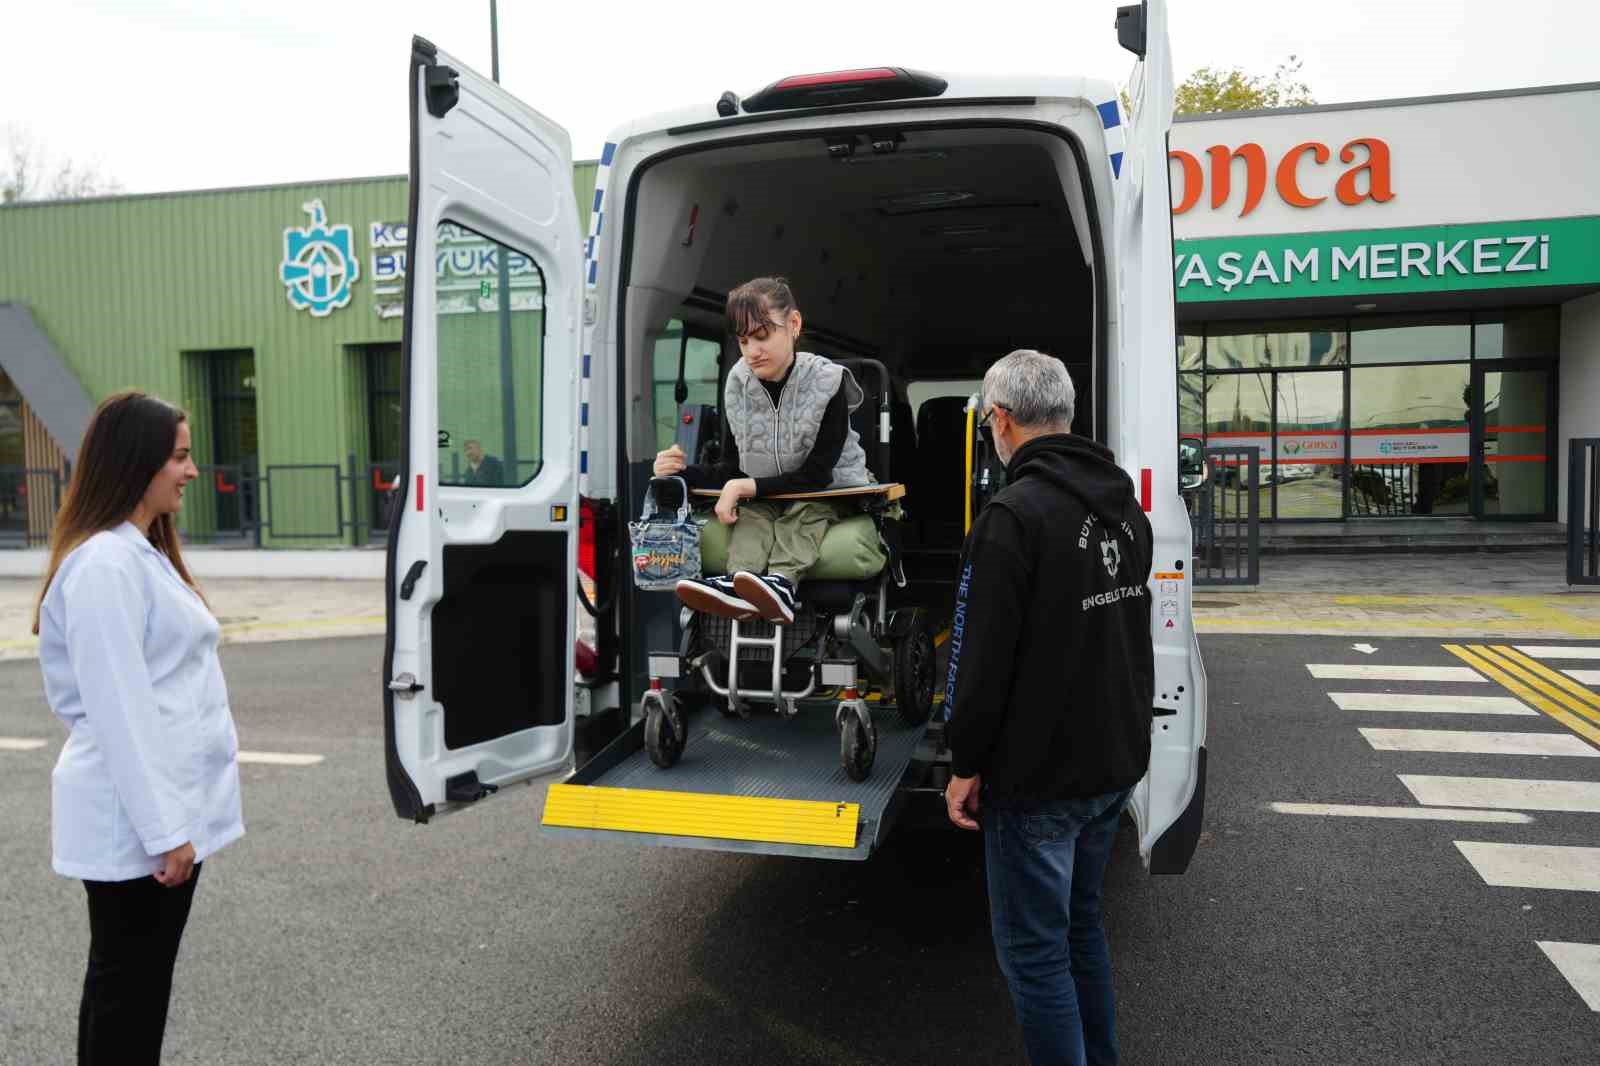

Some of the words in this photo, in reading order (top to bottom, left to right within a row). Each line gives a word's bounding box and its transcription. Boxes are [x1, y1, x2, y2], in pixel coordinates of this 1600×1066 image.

[1168, 137, 1396, 219] onca
[959, 564, 973, 599] THE
[950, 600, 968, 663] NORTH
[945, 662, 959, 705] FACE
